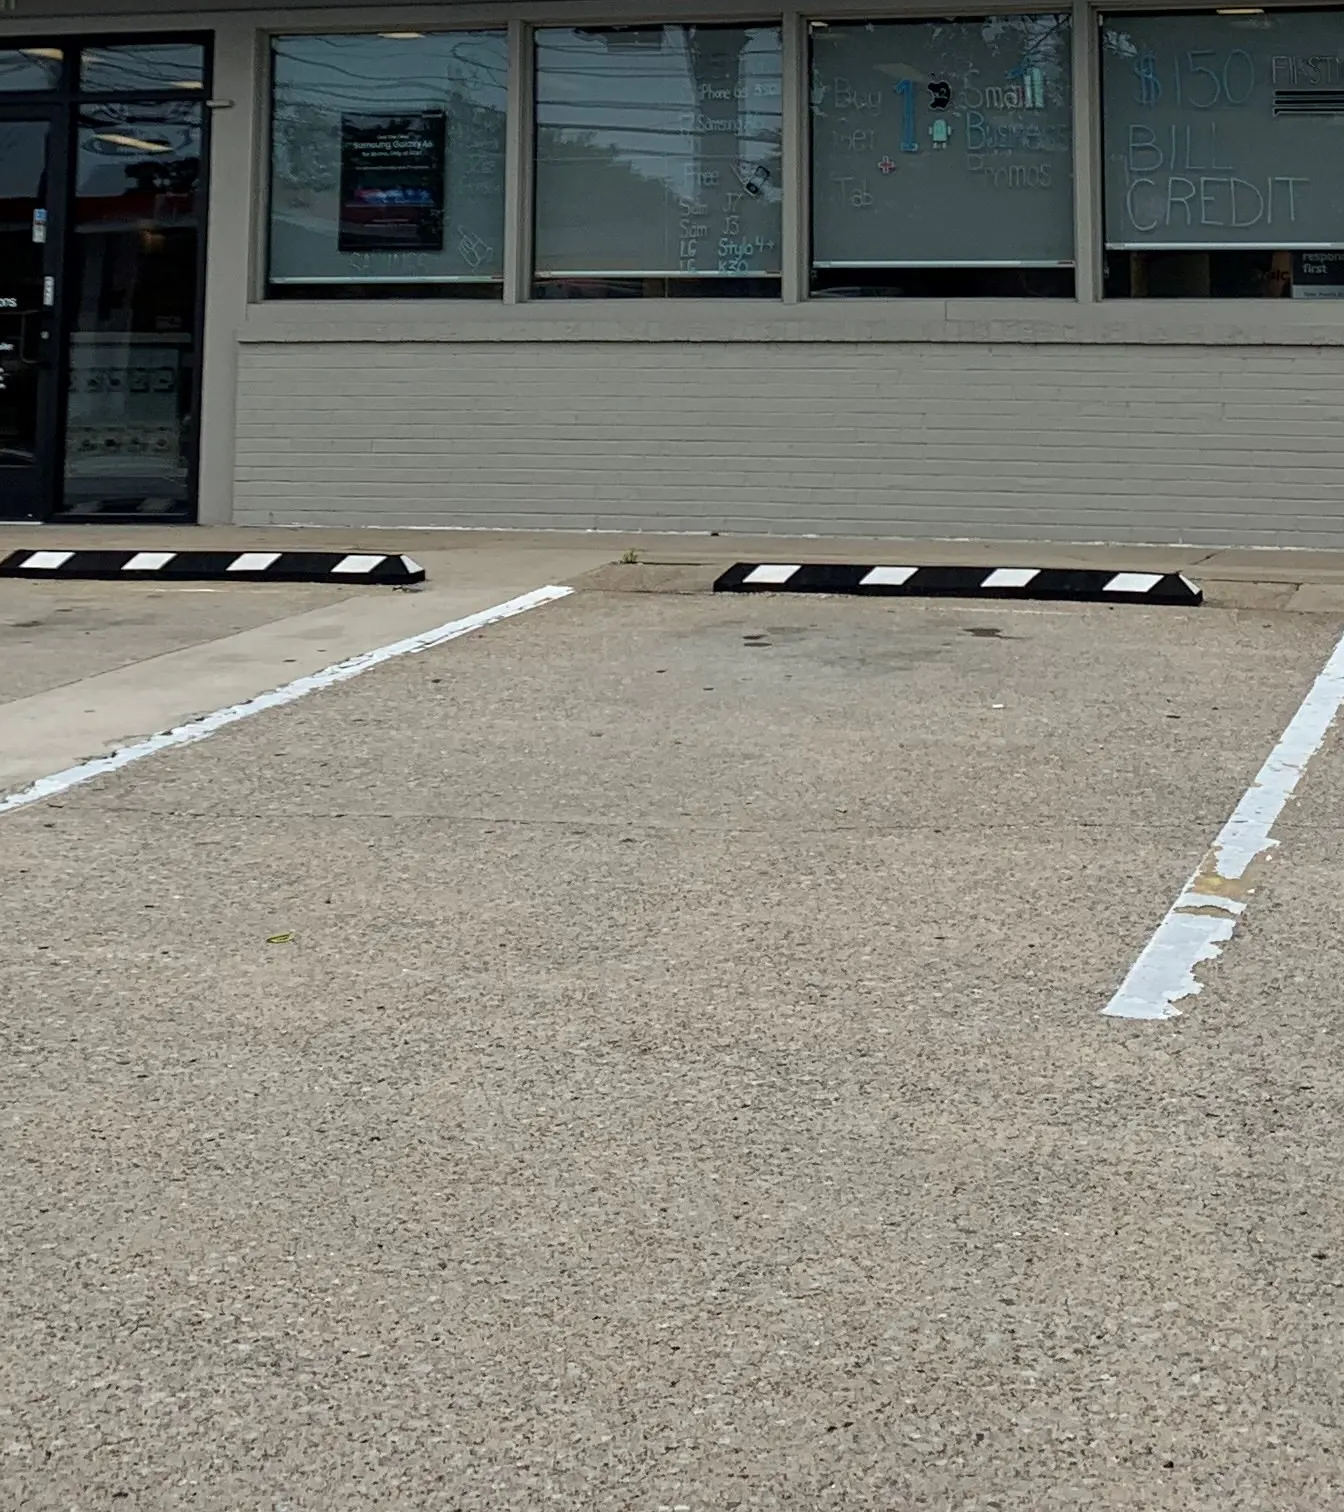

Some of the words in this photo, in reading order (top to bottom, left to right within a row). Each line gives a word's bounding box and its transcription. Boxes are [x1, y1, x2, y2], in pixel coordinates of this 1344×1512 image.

[1134, 49, 1255, 108] $150
[833, 76, 883, 117] Buy
[353, 141, 391, 150] Samsung
[392, 140, 421, 149] Galaxy
[1128, 121, 1236, 172] BILL
[1126, 176, 1311, 231] CREDIT
[678, 219, 708, 238] Sam
[722, 215, 740, 235] J3
[679, 239, 697, 257] LG
[717, 236, 753, 260] Stylo
[1302, 263, 1329, 275] first
